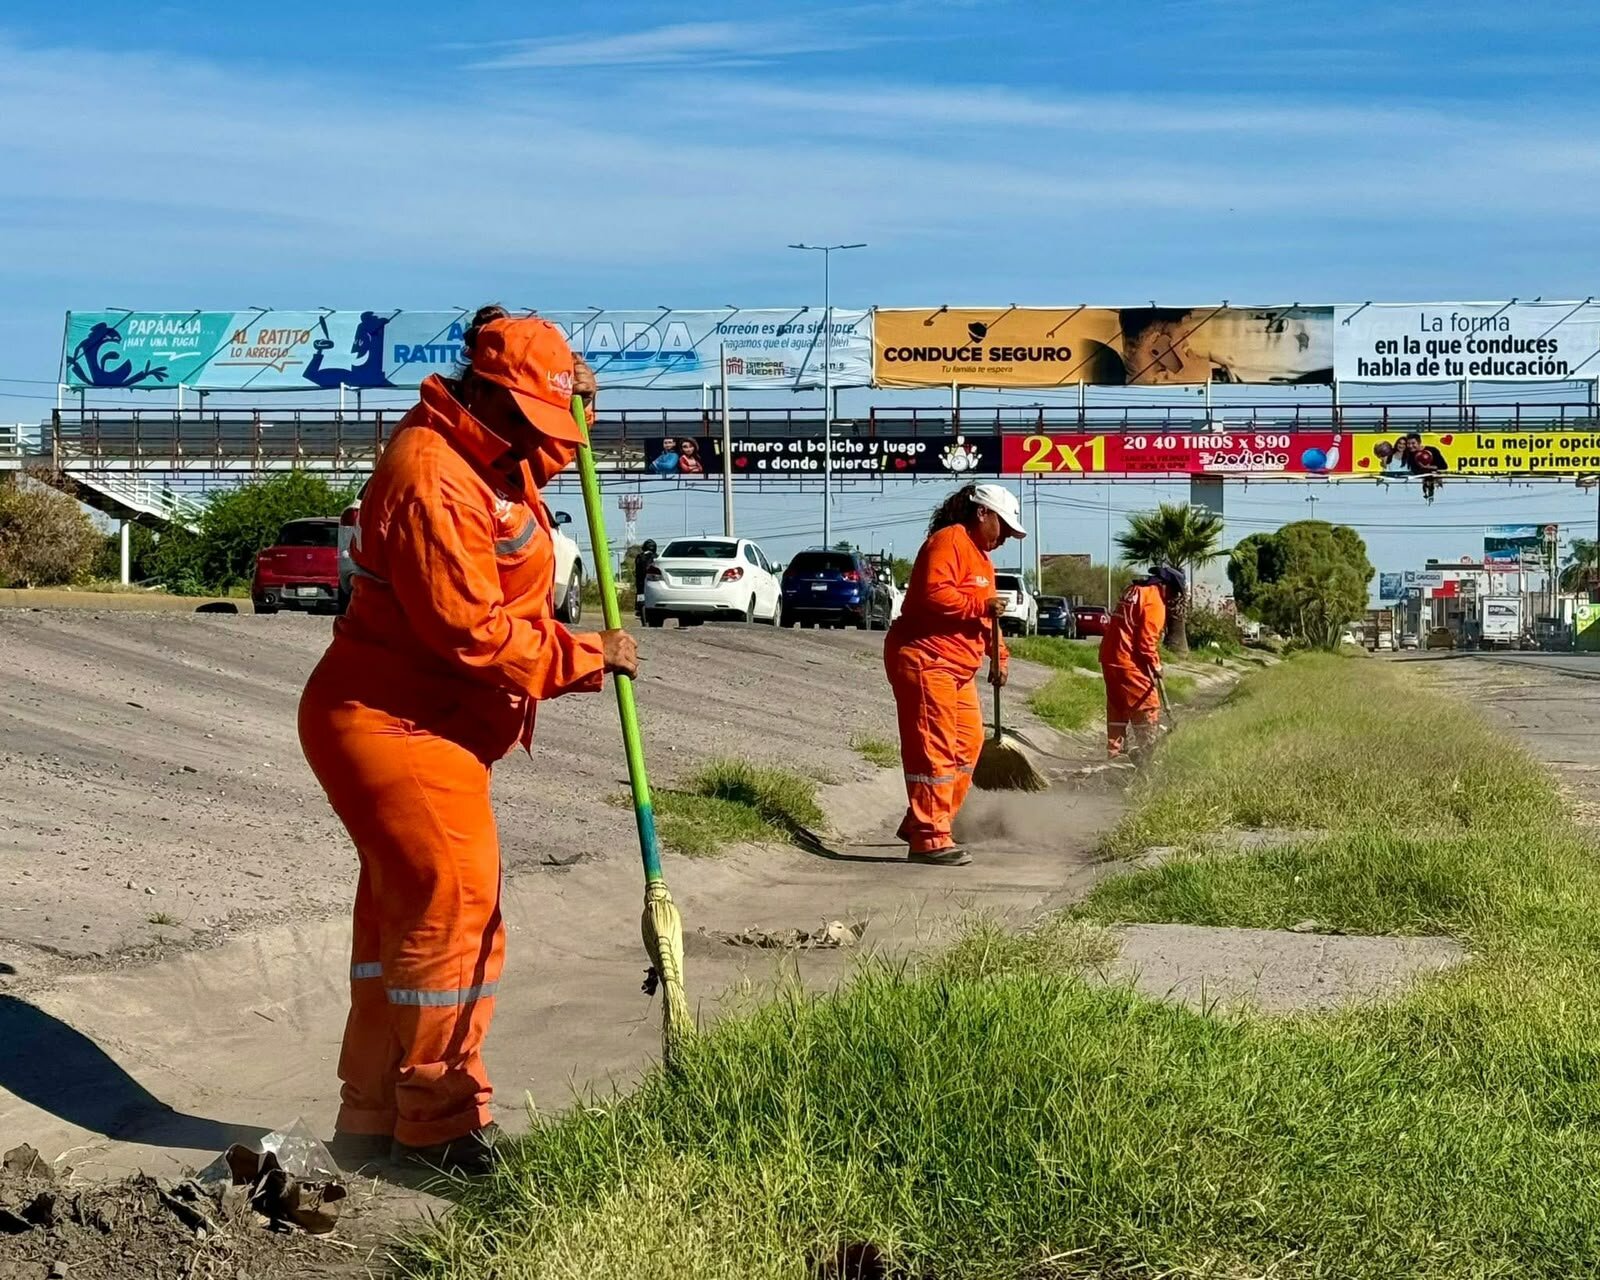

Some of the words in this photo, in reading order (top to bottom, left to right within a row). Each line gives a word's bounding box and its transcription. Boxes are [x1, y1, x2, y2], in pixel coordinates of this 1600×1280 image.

[716, 320, 760, 335] Torreón
[762, 325, 776, 335] es
[1420, 312, 1443, 332] La
[1450, 312, 1510, 332] forma
[122, 337, 146, 352] ¡HAY
[150, 337, 168, 347] UNA
[172, 337, 199, 348] FUGA!
[231, 329, 248, 345] AL
[257, 329, 311, 345] RATITO
[763, 339, 780, 351] que
[781, 338, 790, 348] el
[230, 347, 242, 358] LO
[884, 346, 982, 362] CONDUCE
[988, 346, 1072, 362] SEGURO
[1375, 338, 1398, 354] en
[1403, 335, 1423, 354] la
[1426, 338, 1462, 359] que
[1466, 334, 1558, 354] conduces
[941, 365, 951, 373] Tu
[986, 366, 1013, 375] espera
[1358, 357, 1411, 376] habla
[1416, 357, 1440, 376] de
[1445, 359, 1464, 376] tu
[1468, 355, 1575, 376] educación.
[713, 439, 783, 455] ¡rimero
[788, 439, 802, 452] al
[807, 438, 864, 452] boiche
[869, 442, 879, 454] y
[883, 440, 926, 456] luego
[1123, 436, 1147, 449] 20
[1153, 436, 1177, 449] 40
[1181, 436, 1233, 449] TIROS
[1238, 438, 1249, 448] x
[1254, 435, 1291, 450] $90
[1476, 435, 1495, 449] La
[1502, 434, 1554, 453] mejor
[1022, 435, 1105, 471] 2x1
[757, 459, 767, 469] a
[771, 456, 818, 469] donde
[1457, 455, 1499, 471] para
[1505, 455, 1522, 467] tu
[1529, 453, 1600, 471] primera
